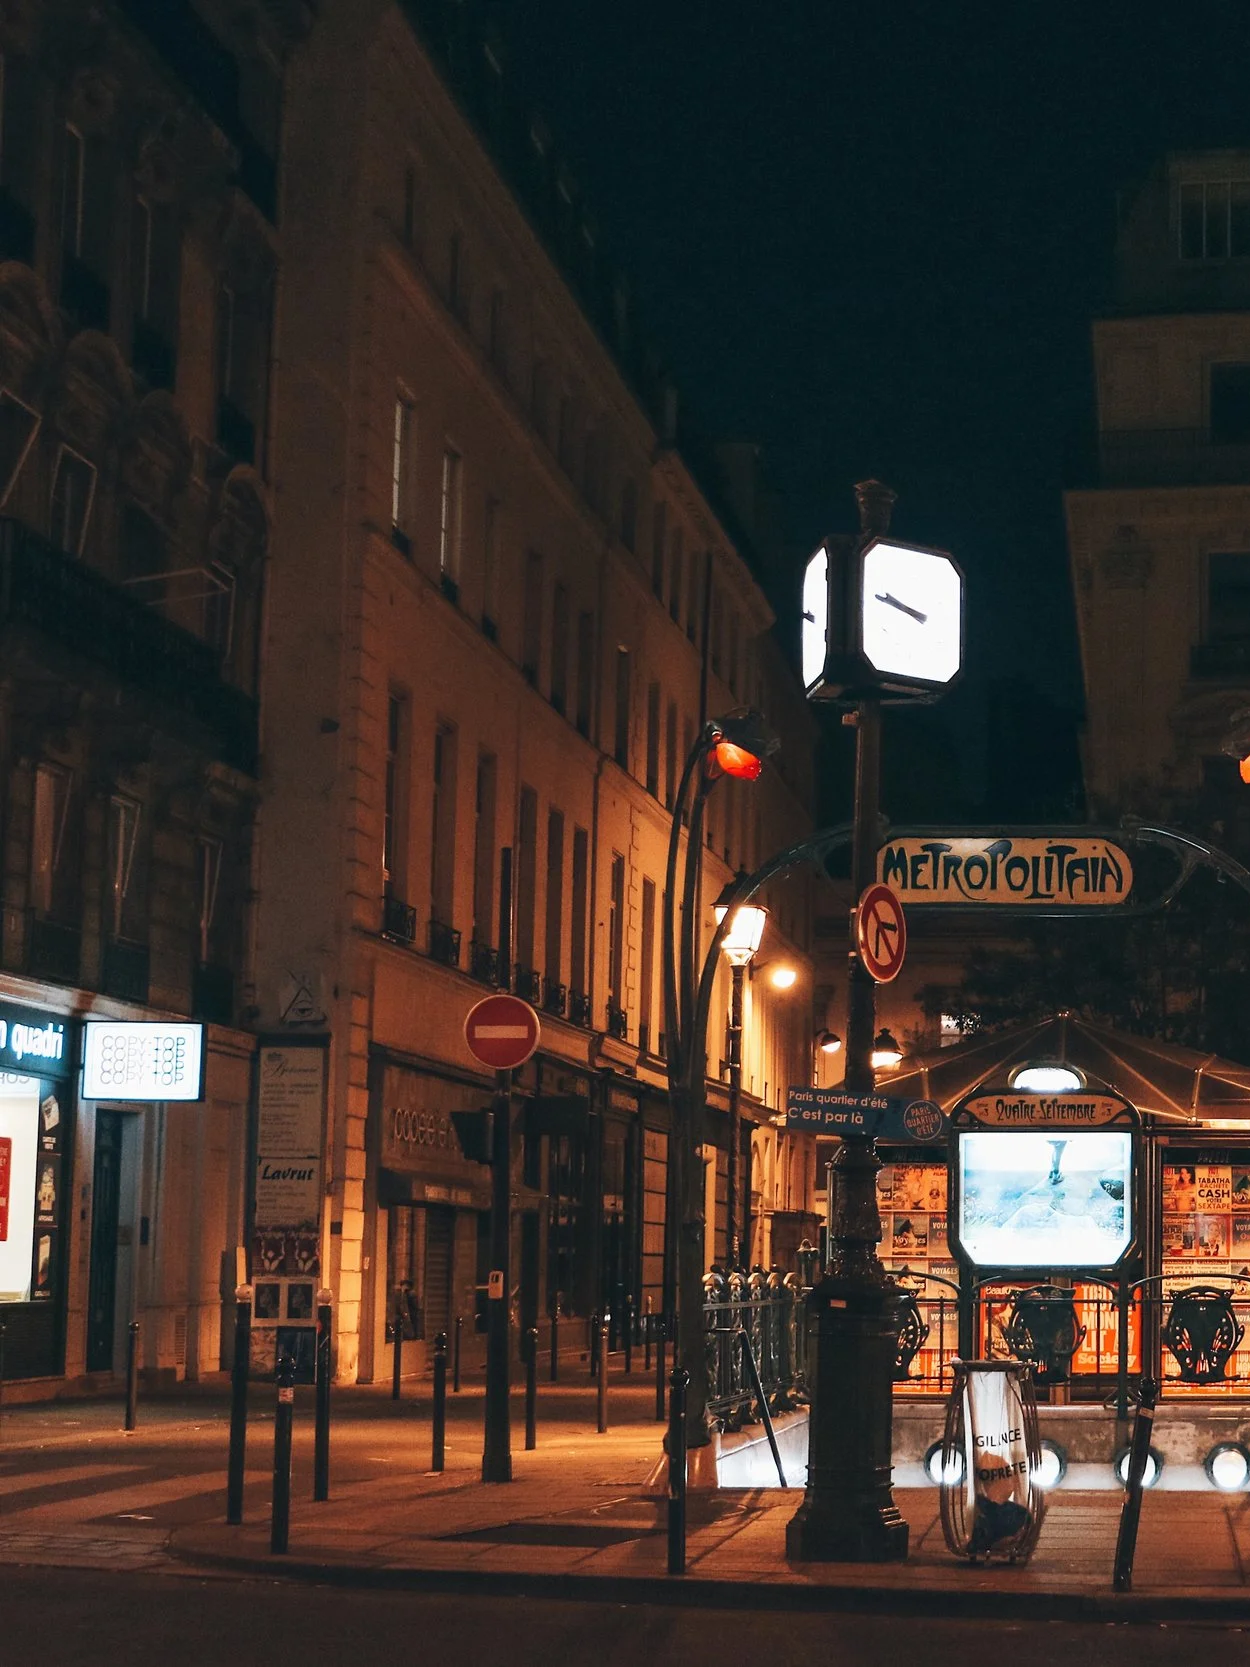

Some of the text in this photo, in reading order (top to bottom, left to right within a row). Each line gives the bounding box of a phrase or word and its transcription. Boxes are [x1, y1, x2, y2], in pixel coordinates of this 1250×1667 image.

[883, 839, 1122, 900] METROPOLITAIN
[11, 1023, 64, 1061] quadri
[102, 1035, 186, 1050] COPY-TOP
[788, 1090, 889, 1109] Paris quartier d'été
[787, 1107, 864, 1125] C'est par là
[910, 1105, 930, 1117] PARIS
[1198, 1189, 1230, 1199] CASH
[1081, 1310, 1133, 1330] MONE
[1077, 1351, 1137, 1368] Sociey
